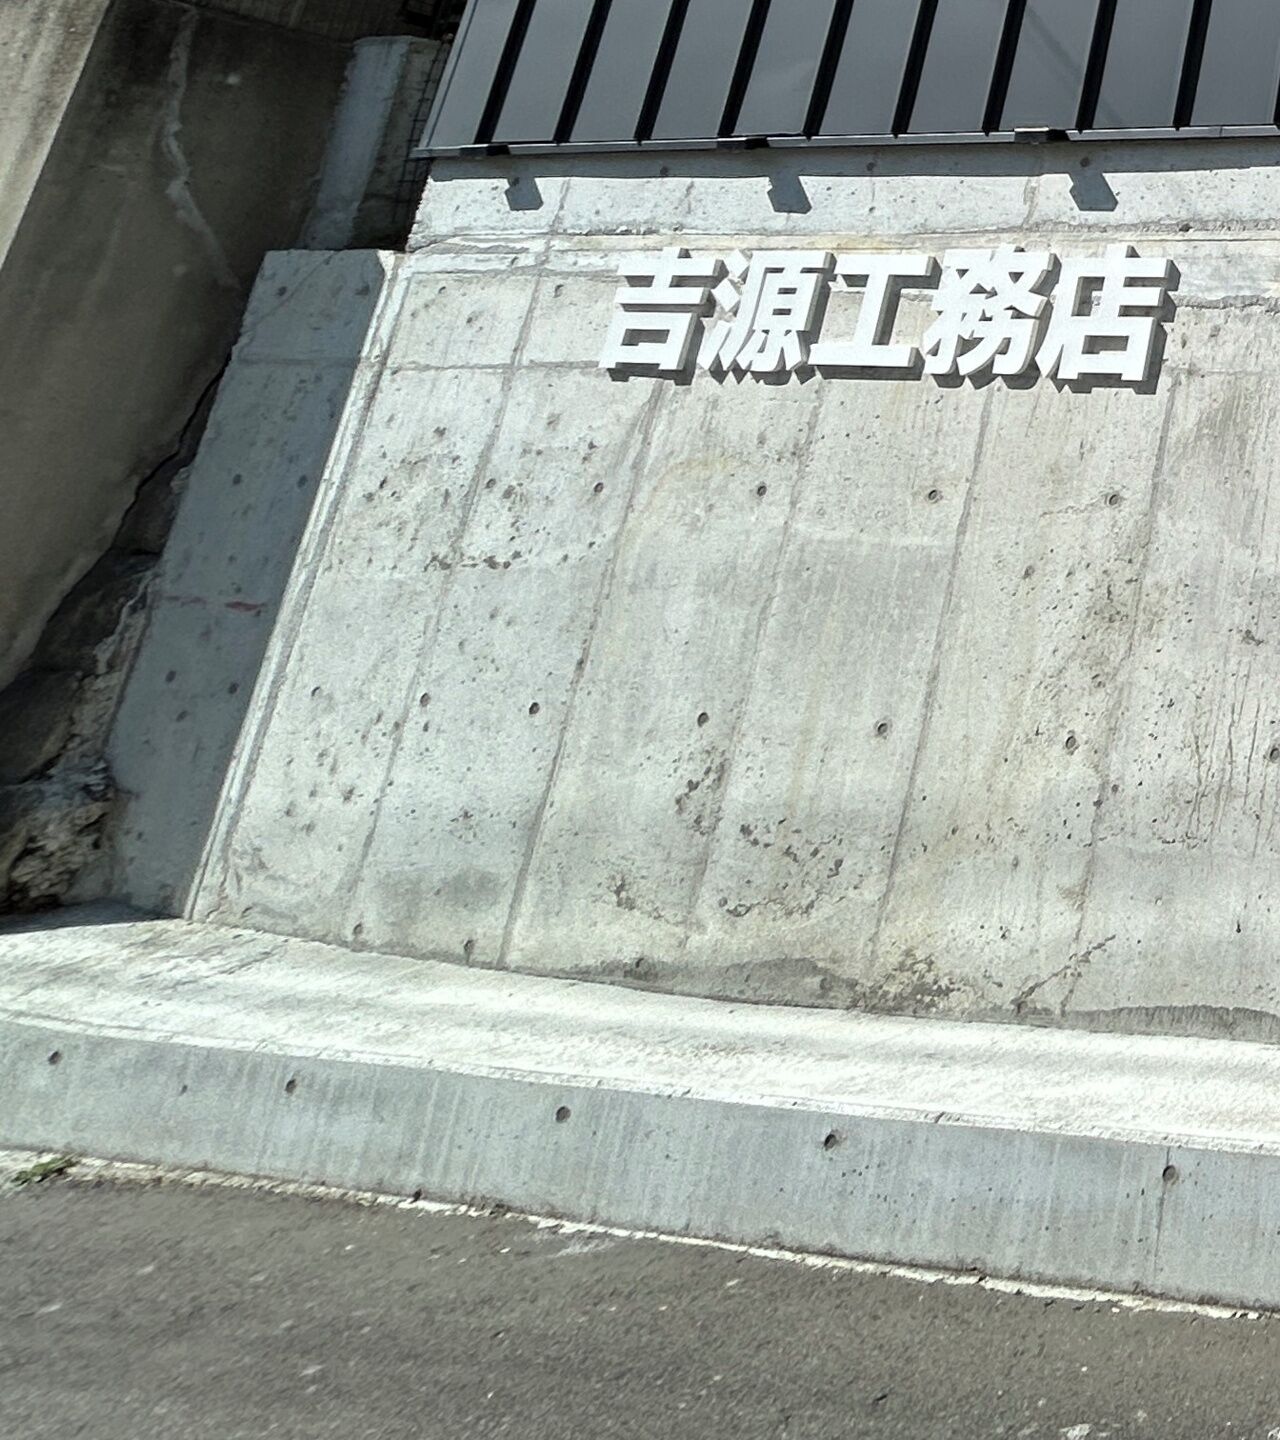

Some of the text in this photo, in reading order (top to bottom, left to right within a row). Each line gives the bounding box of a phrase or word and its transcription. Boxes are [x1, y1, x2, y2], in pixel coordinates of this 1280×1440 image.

[599, 244, 1176, 387] 吉源工務店
